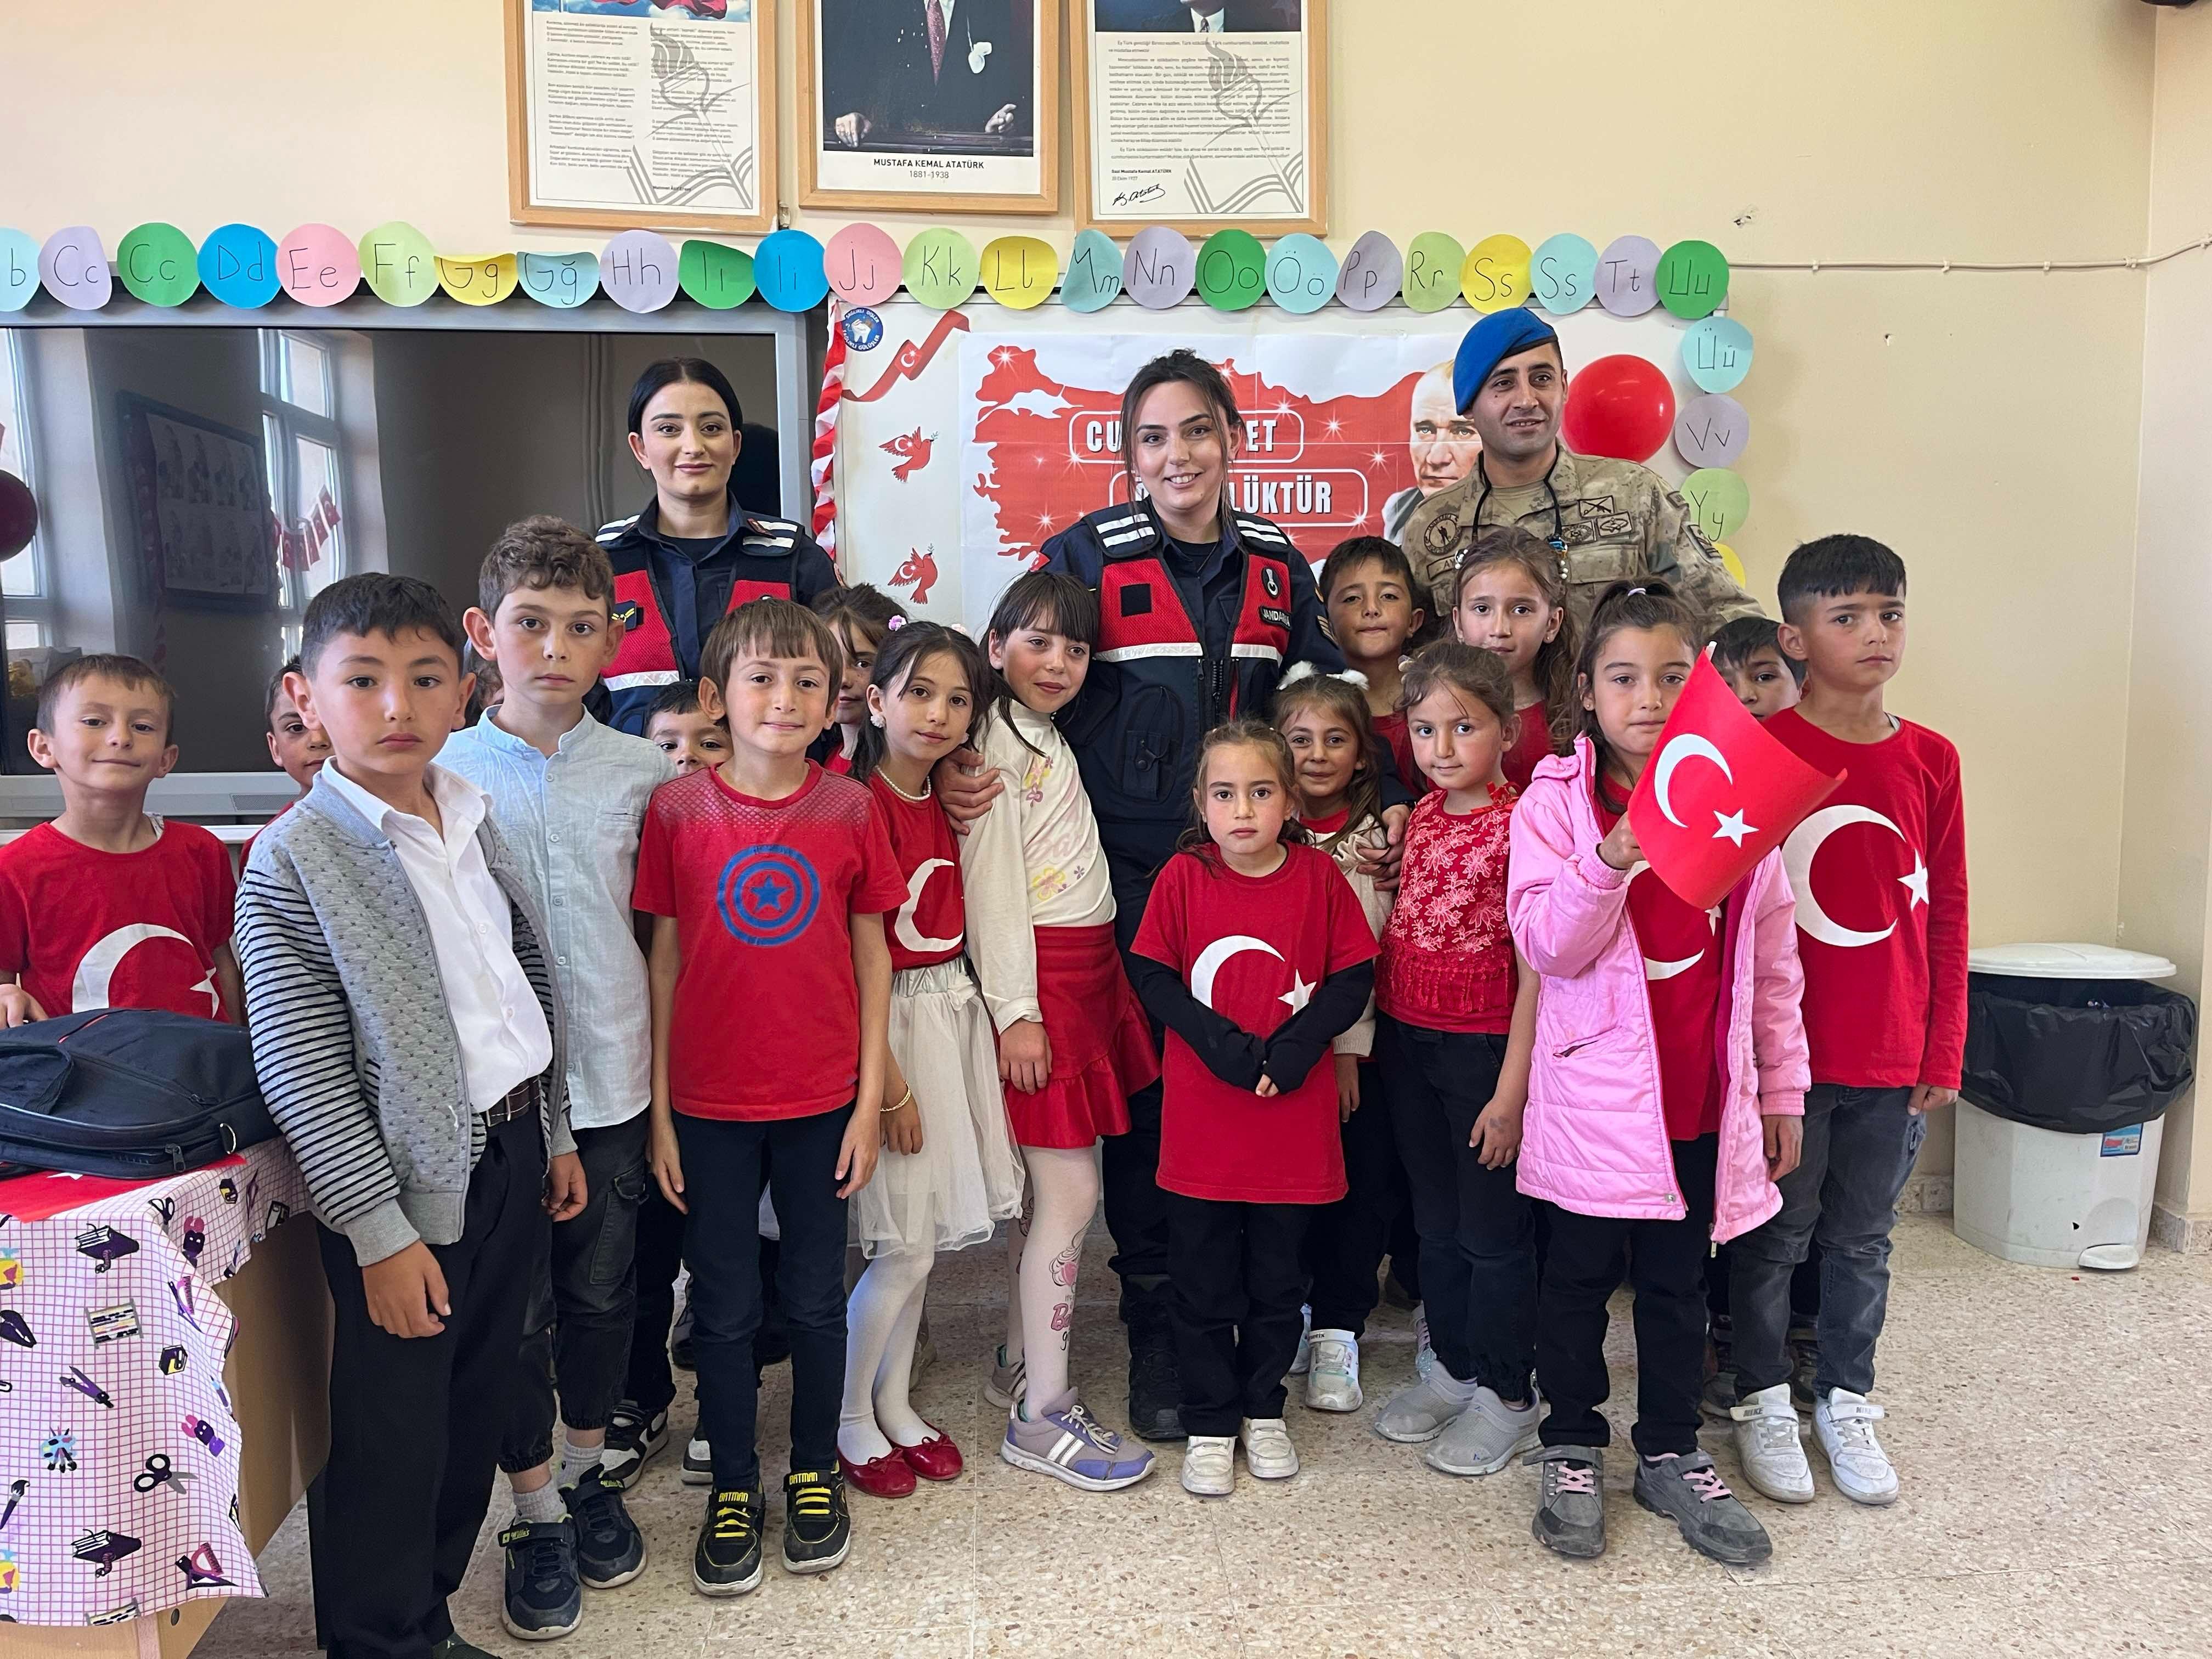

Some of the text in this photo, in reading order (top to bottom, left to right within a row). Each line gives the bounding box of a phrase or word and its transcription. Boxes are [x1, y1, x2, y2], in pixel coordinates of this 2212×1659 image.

[873, 158, 984, 169] MUSTAFA KEMAL ATATÜRK
[909, 170, 949, 179] 1881-1938
[54, 245, 98, 286] Cc
[218, 241, 264, 281] Dd
[288, 248, 338, 290] Ee
[374, 244, 419, 289] Ff
[612, 247, 661, 285] Hh
[838, 240, 874, 290] Jj
[922, 245, 961, 286] Kk
[995, 250, 1032, 291] Ll
[1073, 247, 1119, 294] Mm
[1133, 247, 1174, 286] Nn
[1203, 250, 1259, 294] Oo
[1273, 250, 1324, 295] Öö
[1344, 251, 1377, 298] Pp
[1410, 251, 1443, 291] Rr
[1474, 257, 1513, 301] Ss
[1605, 259, 1640, 293] Tt
[1668, 259, 1710, 296] Uu
[1698, 328, 1735, 369] Üü
[1686, 417, 1730, 451] Vv
[1690, 490, 1724, 542] Yy
[1743, 1407, 1764, 1417] NIKE
[1856, 1406, 1871, 1414] NIKE
[718, 1492, 749, 1503] BATMAN
[789, 1472, 818, 1485] BATMAN
